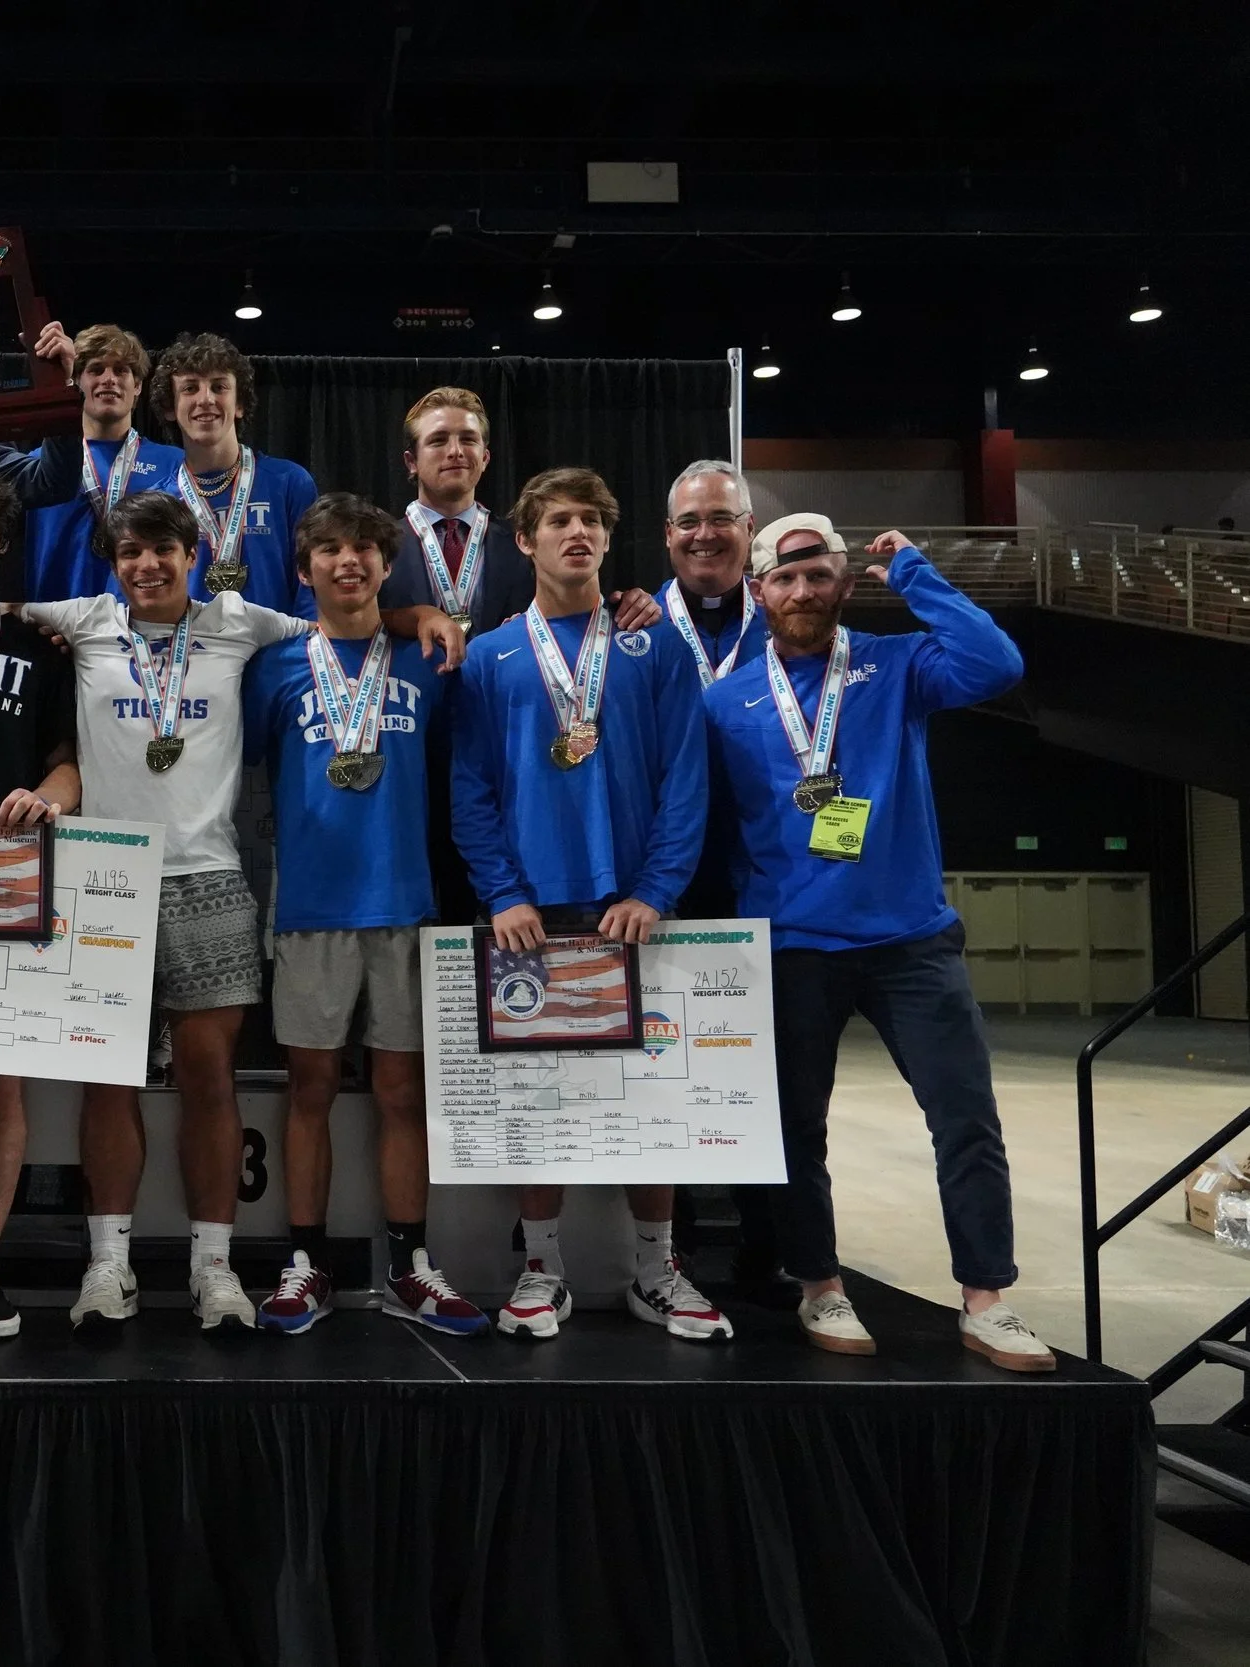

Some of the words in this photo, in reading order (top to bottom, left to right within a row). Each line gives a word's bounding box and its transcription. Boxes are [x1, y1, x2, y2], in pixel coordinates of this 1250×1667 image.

[229, 487, 247, 535] WRESTLING
[460, 543, 478, 590] WRESTLING
[677, 616, 704, 666] WRESTLING
[587, 652, 603, 709] WRESTLING
[319, 671, 341, 725] WRESTLING
[351, 676, 373, 730] WRESTLING
[817, 693, 836, 753] WRESTLING
[15, 828, 37, 836] Fame
[4, 836, 37, 844] Museum
[86, 870, 99, 887] 2A
[104, 870, 129, 888] 195
[84, 888, 113, 898] WEIGHT
[114, 890, 136, 899] CLASS
[79, 936, 135, 949] CHAMPION
[434, 938, 468, 950] 2022
[568, 939, 586, 947] Hall
[586, 945, 621, 953] Museum
[694, 971, 711, 988] 2A
[715, 968, 740, 988] 152
[724, 989, 747, 997] CLASS
[69, 1034, 83, 1043] 3rd
[84, 1036, 107, 1045] Place
[693, 1038, 752, 1048] CHAMPION
[238, 1128, 267, 1202] 3
